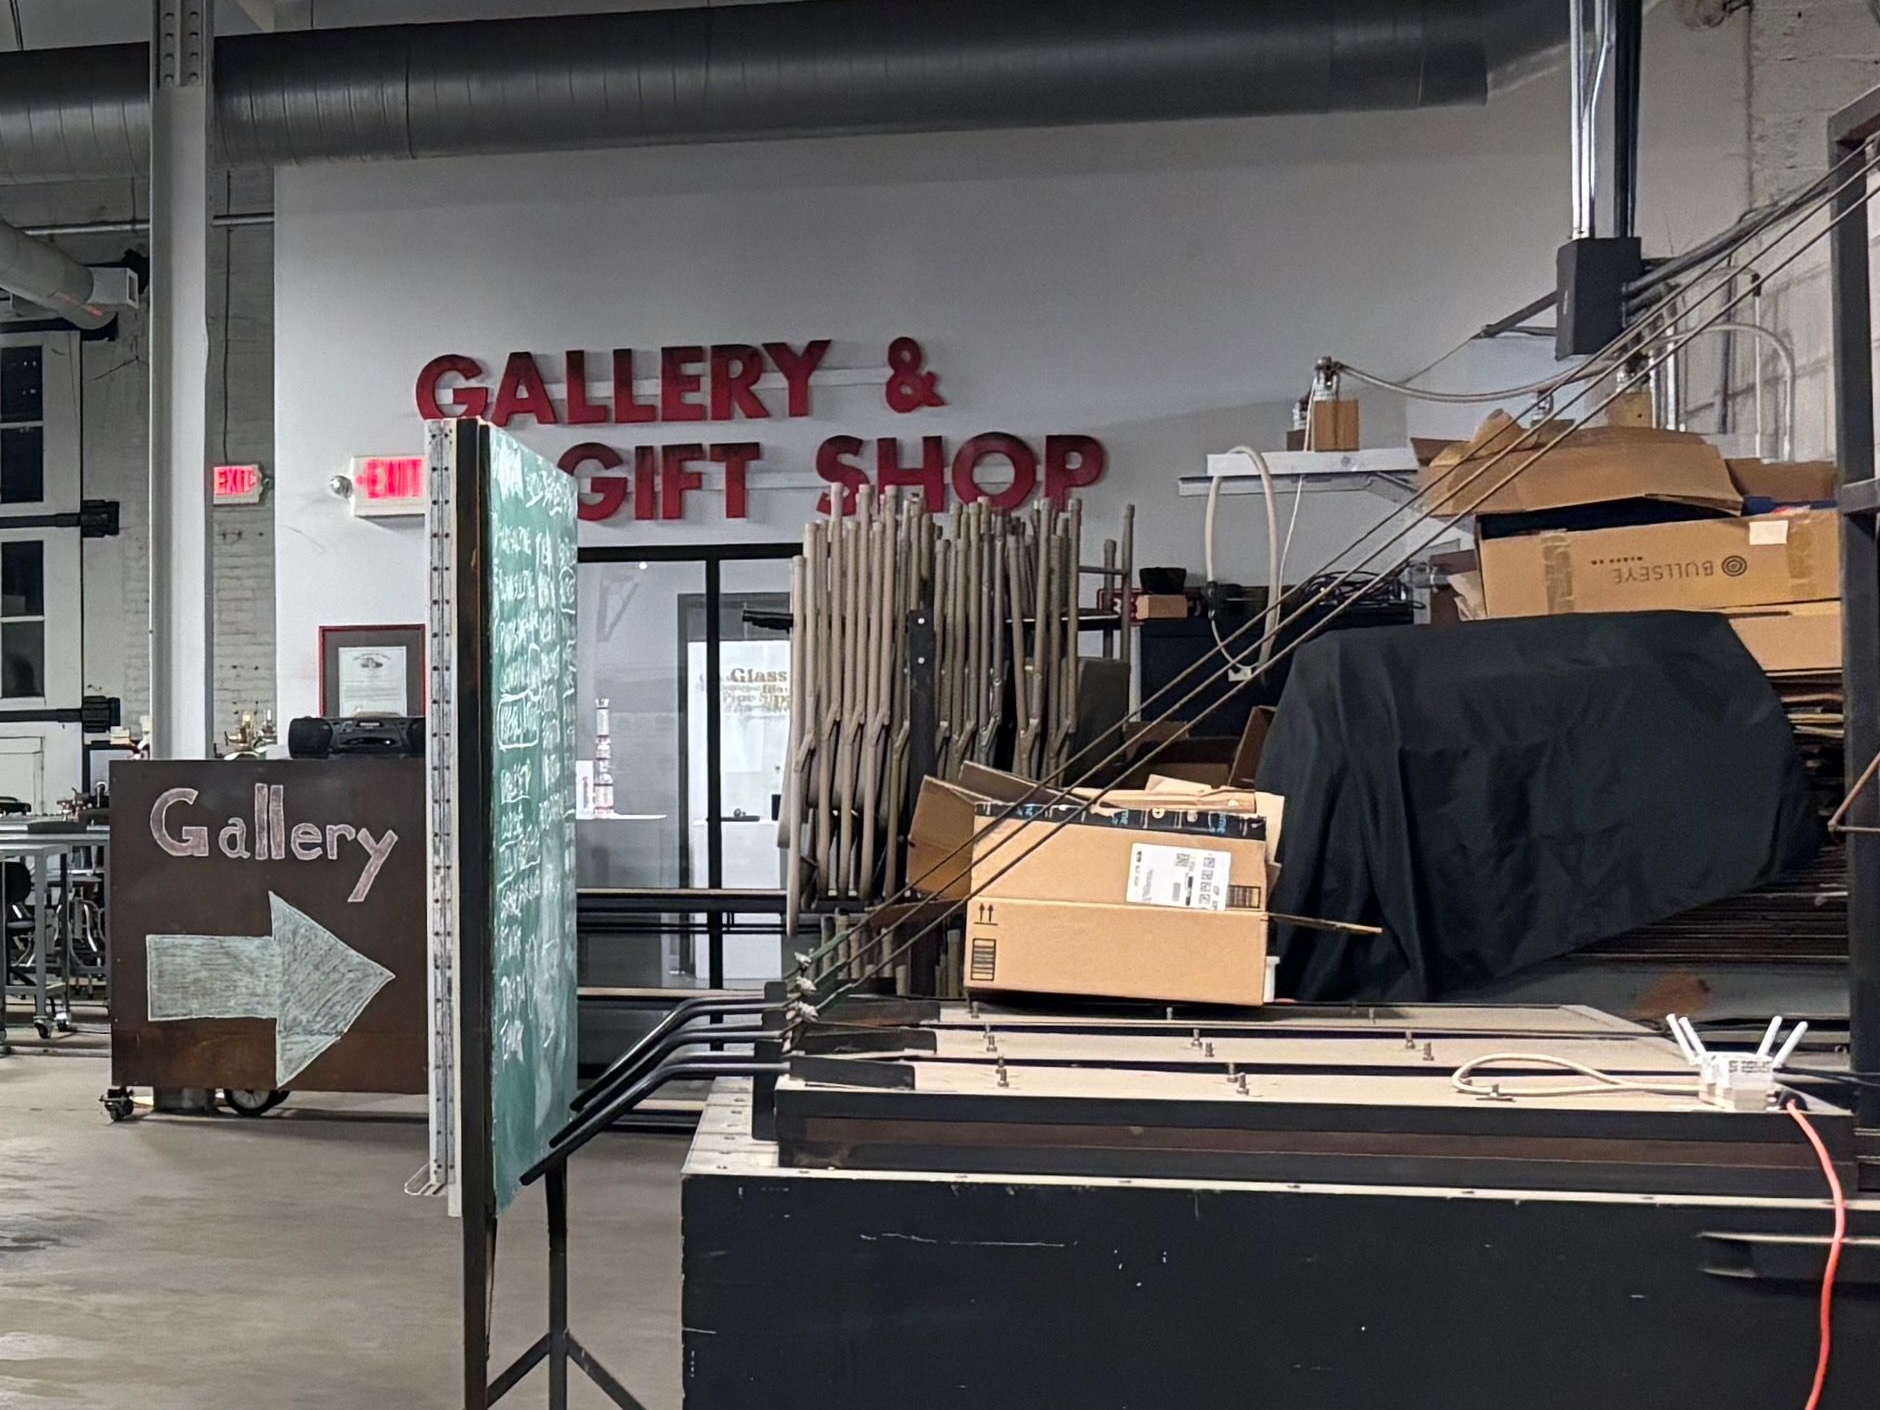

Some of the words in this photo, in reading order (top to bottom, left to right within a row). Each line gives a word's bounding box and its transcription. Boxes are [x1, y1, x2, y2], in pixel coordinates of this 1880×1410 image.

[415, 341, 832, 427] GALLERY
[885, 336, 948, 414] &
[217, 467, 251, 495] EXIT
[557, 442, 760, 521] GIFT
[816, 432, 1106, 517] SHOP
[1611, 560, 1714, 585] BULLSEYE
[730, 668, 788, 684] Glass
[150, 783, 400, 903] Gallery
